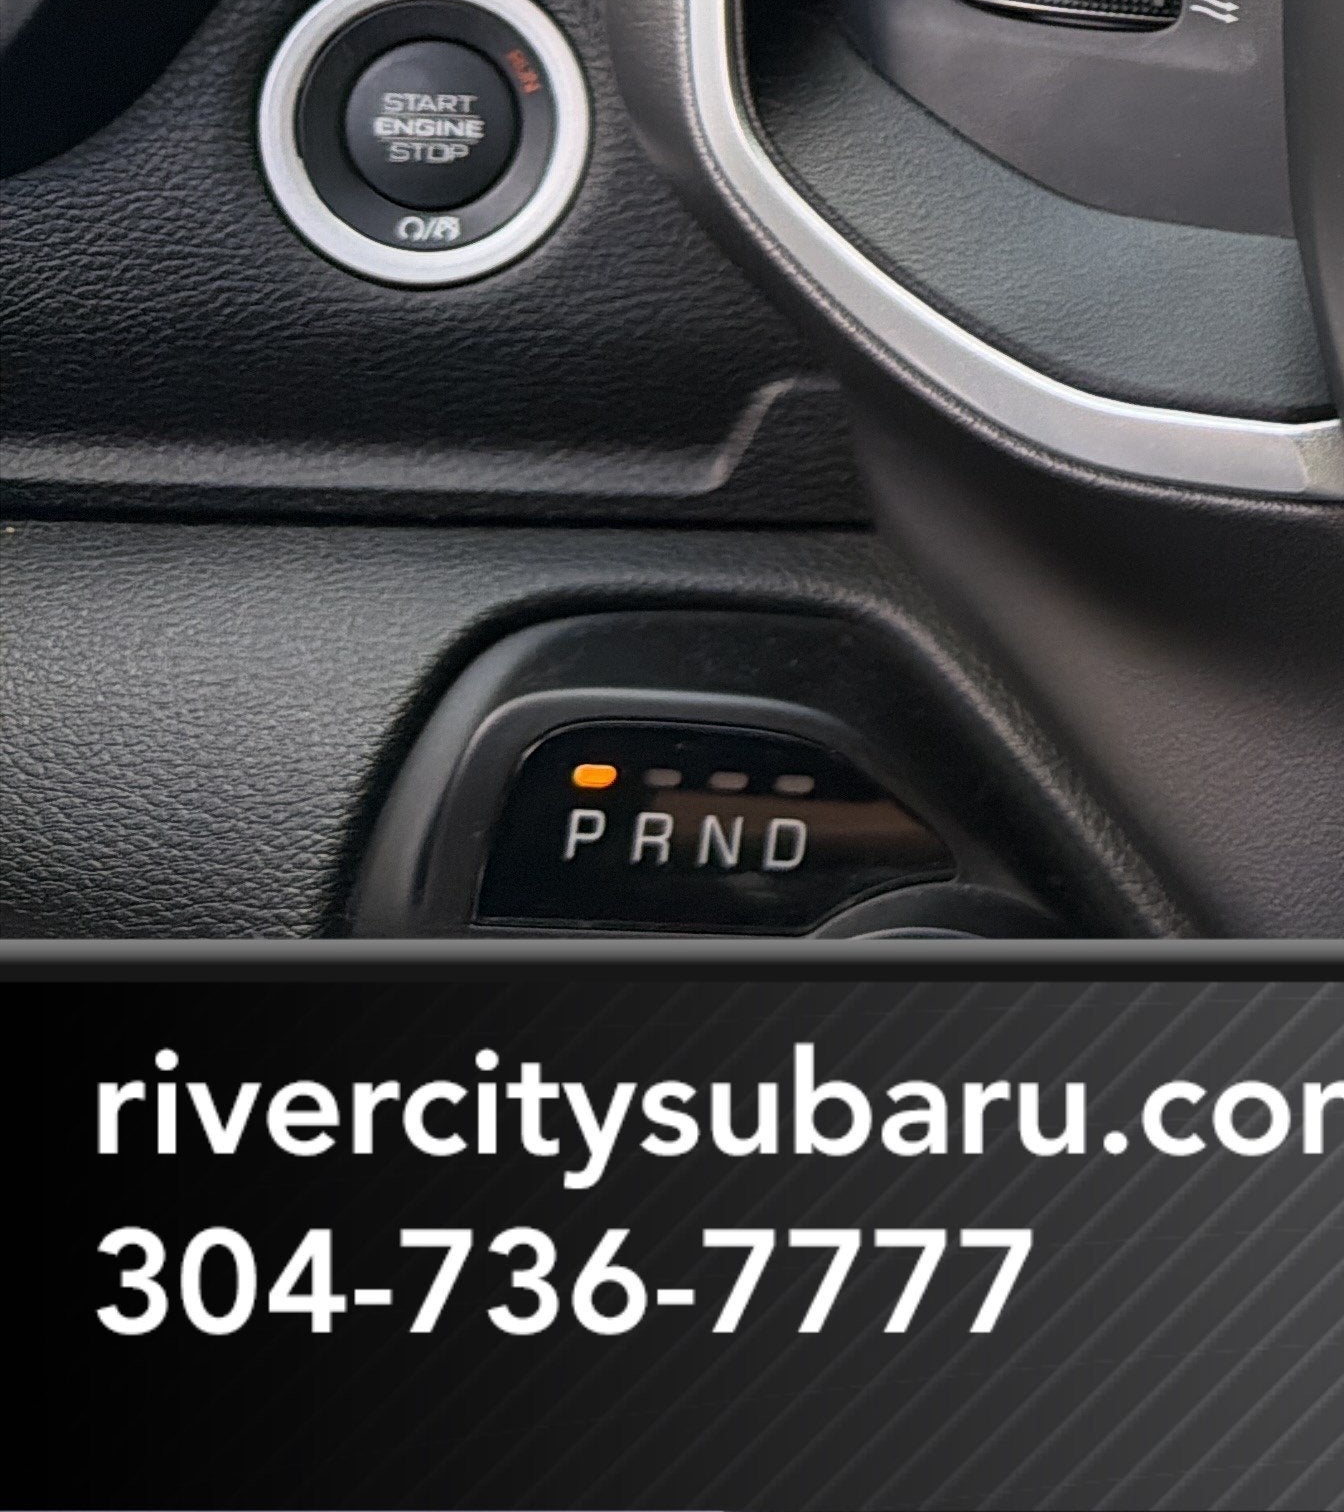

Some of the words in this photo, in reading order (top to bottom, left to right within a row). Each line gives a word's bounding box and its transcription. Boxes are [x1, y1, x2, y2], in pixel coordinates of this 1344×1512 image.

[381, 92, 478, 113] START
[373, 117, 486, 139] ENGINE
[388, 142, 471, 164] STOP
